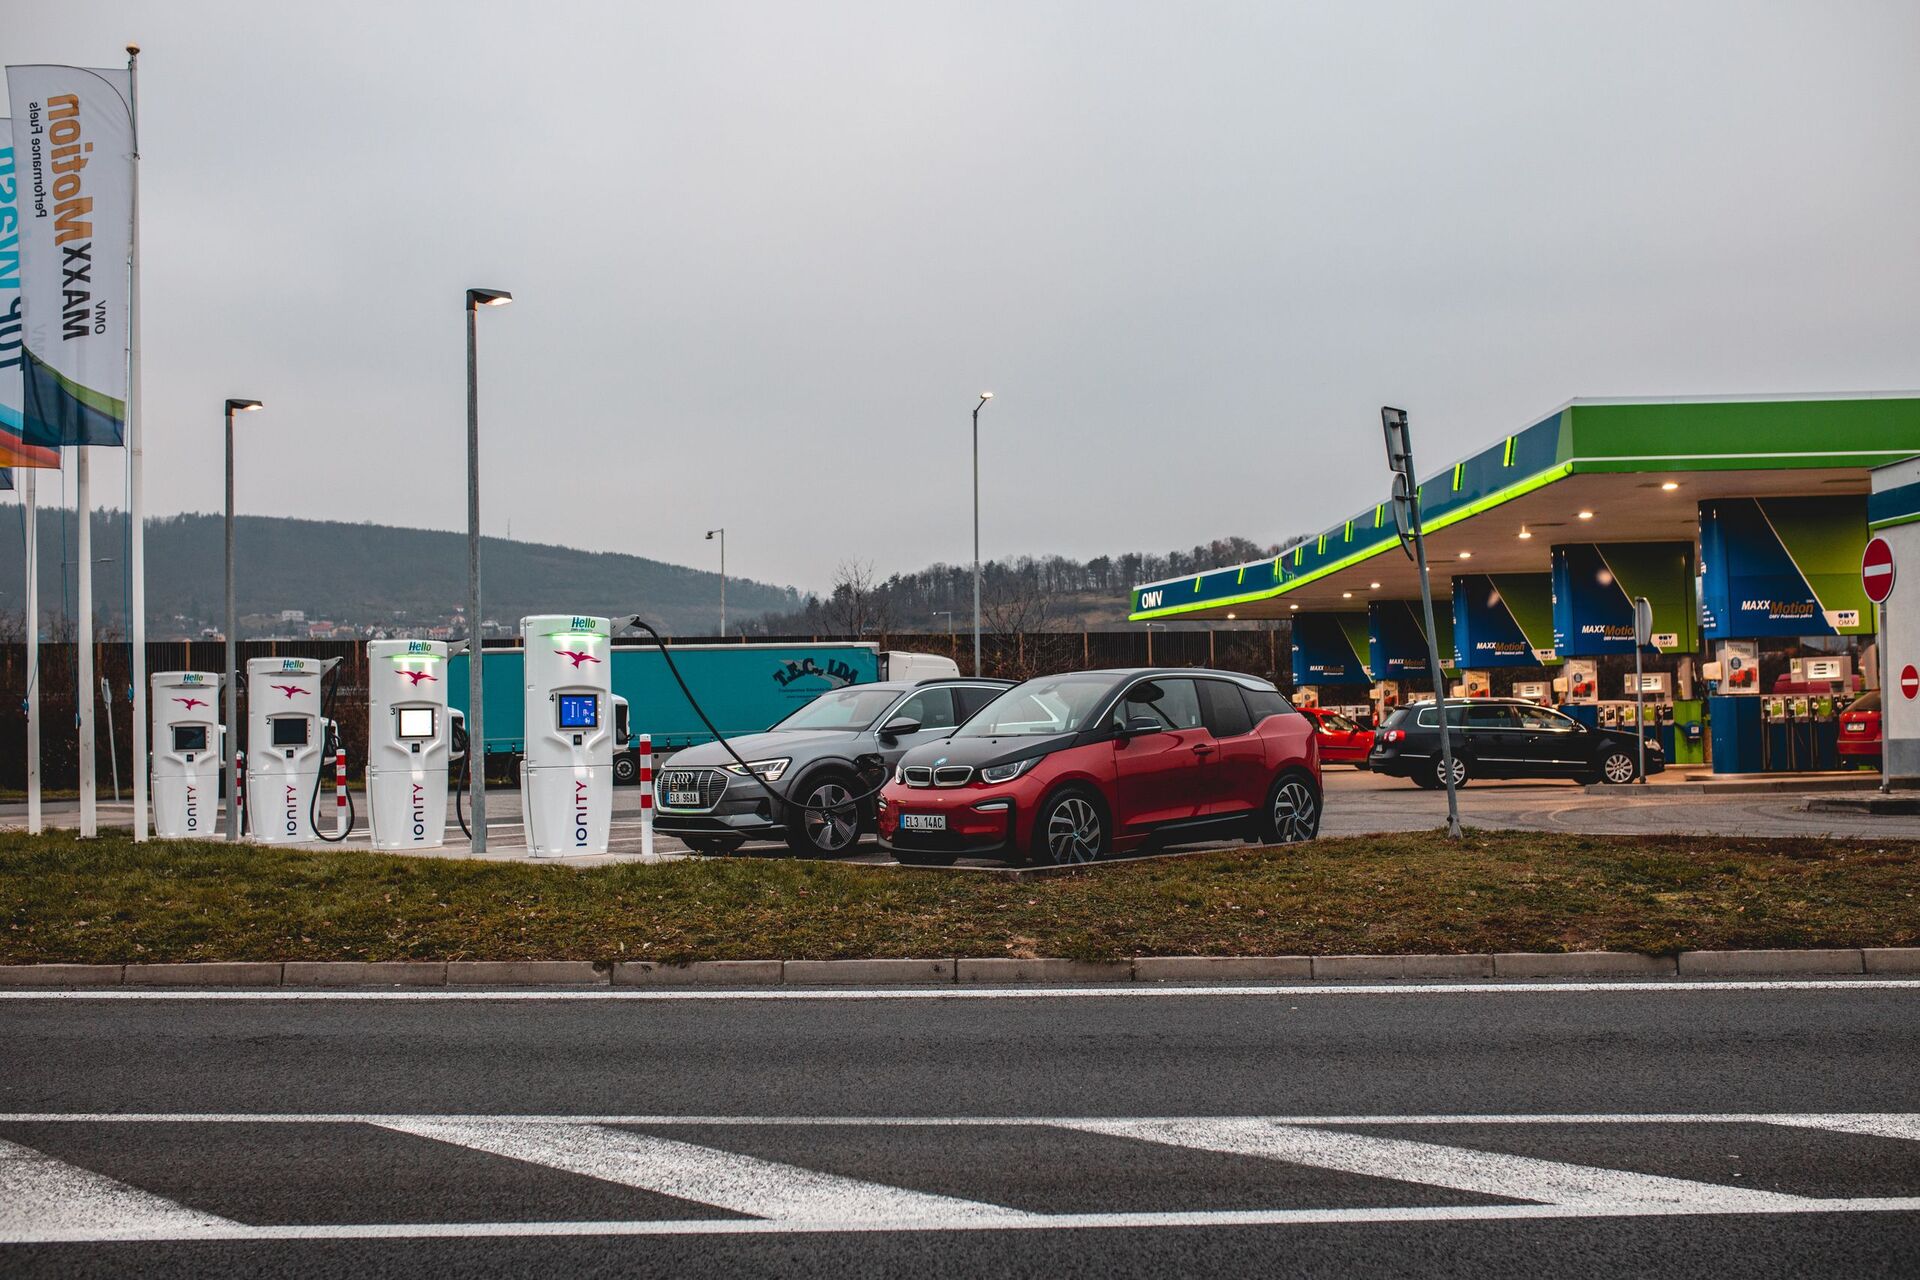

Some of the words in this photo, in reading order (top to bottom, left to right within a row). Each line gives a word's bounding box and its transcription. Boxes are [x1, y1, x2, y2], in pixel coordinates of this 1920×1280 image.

[1141, 590, 1163, 609] OMV
[571, 617, 596, 629] Hello
[409, 641, 432, 652] Hello
[282, 659, 305, 669] Hello
[183, 673, 204, 682] Hello
[549, 693, 555, 702] 4
[390, 707, 396, 715] 3
[266, 717, 271, 725] 2
[186, 785, 197, 832] IONITY
[286, 785, 297, 836] IONITY
[413, 783, 425, 841] IONITY
[575, 780, 588, 847] IONITY
[905, 816, 919, 828] EL3
[923, 816, 943, 829] 14AC
